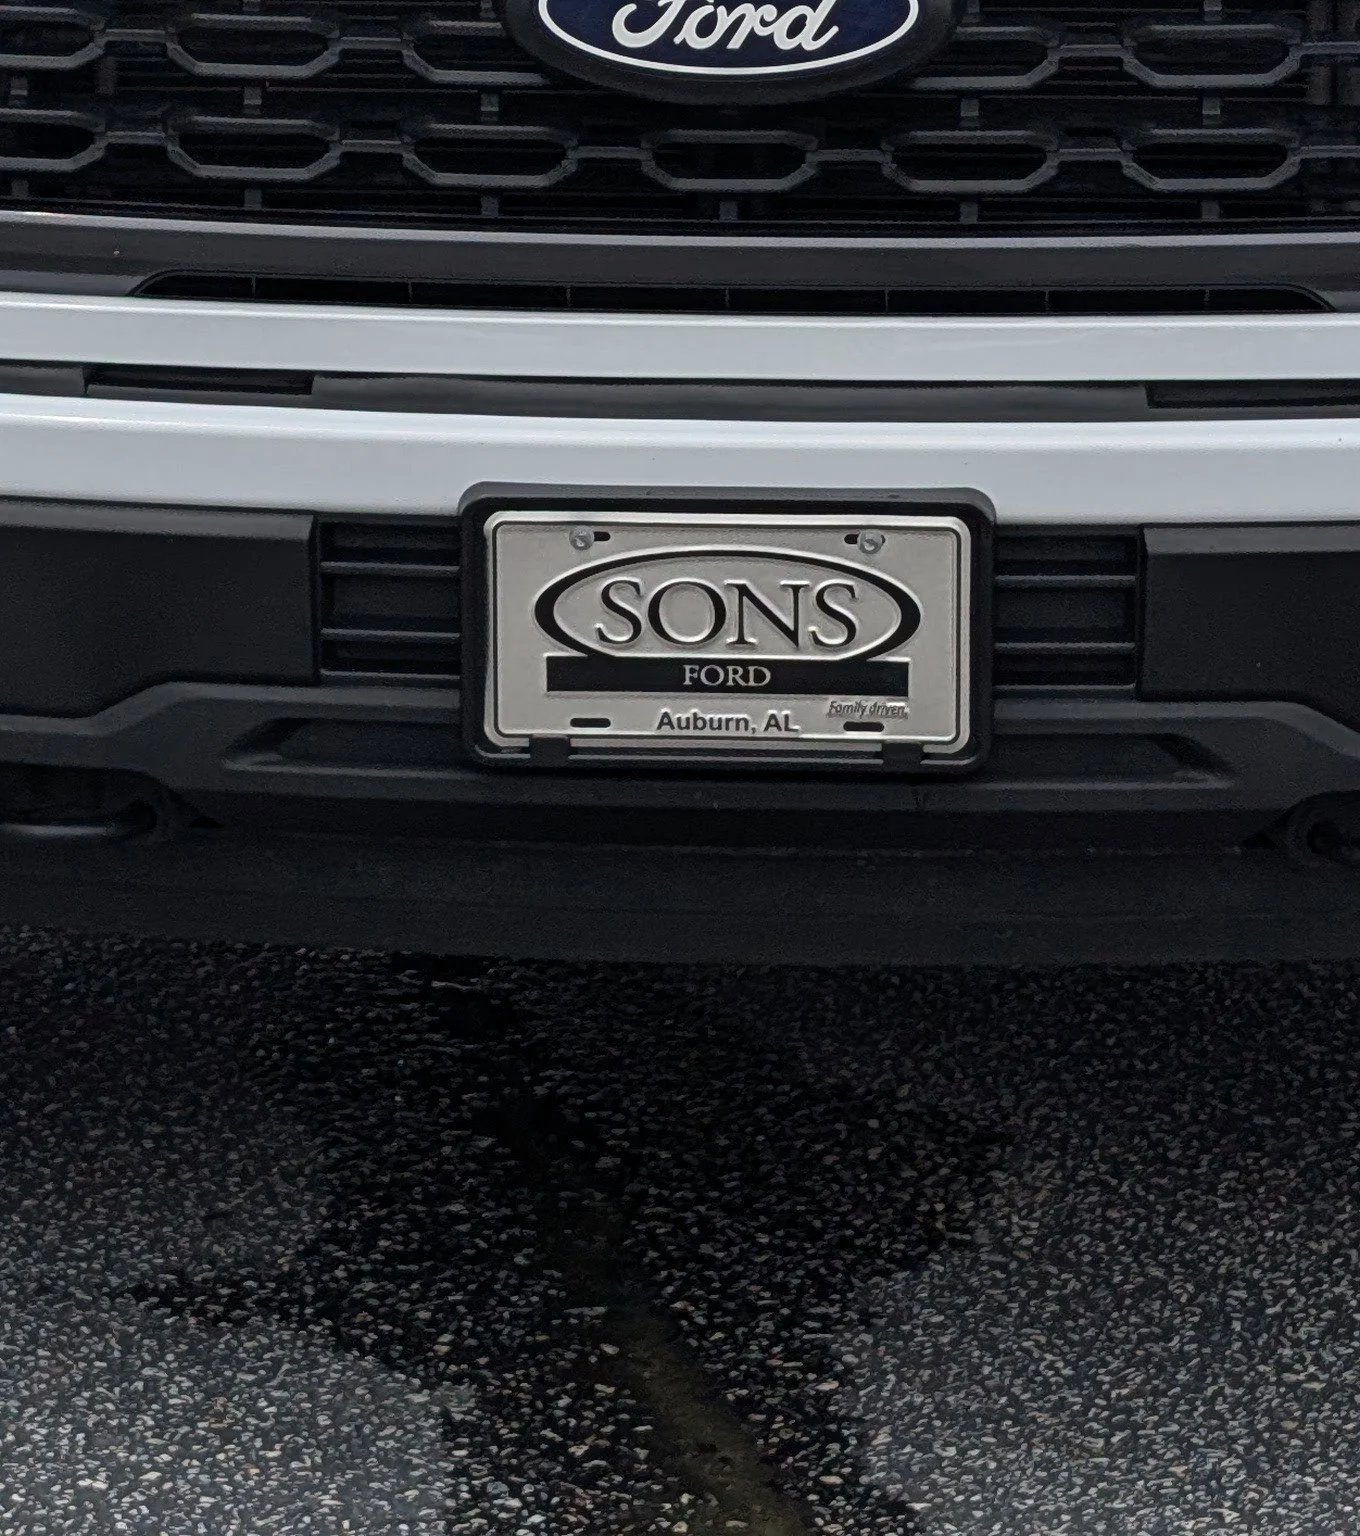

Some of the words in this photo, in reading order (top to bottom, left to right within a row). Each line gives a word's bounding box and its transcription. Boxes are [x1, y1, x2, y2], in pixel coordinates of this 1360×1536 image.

[595, 579, 857, 650] SONS
[683, 665, 772, 688] FORD
[827, 700, 867, 719] Family
[657, 711, 757, 734] Auburn,
[762, 713, 800, 733] AL
